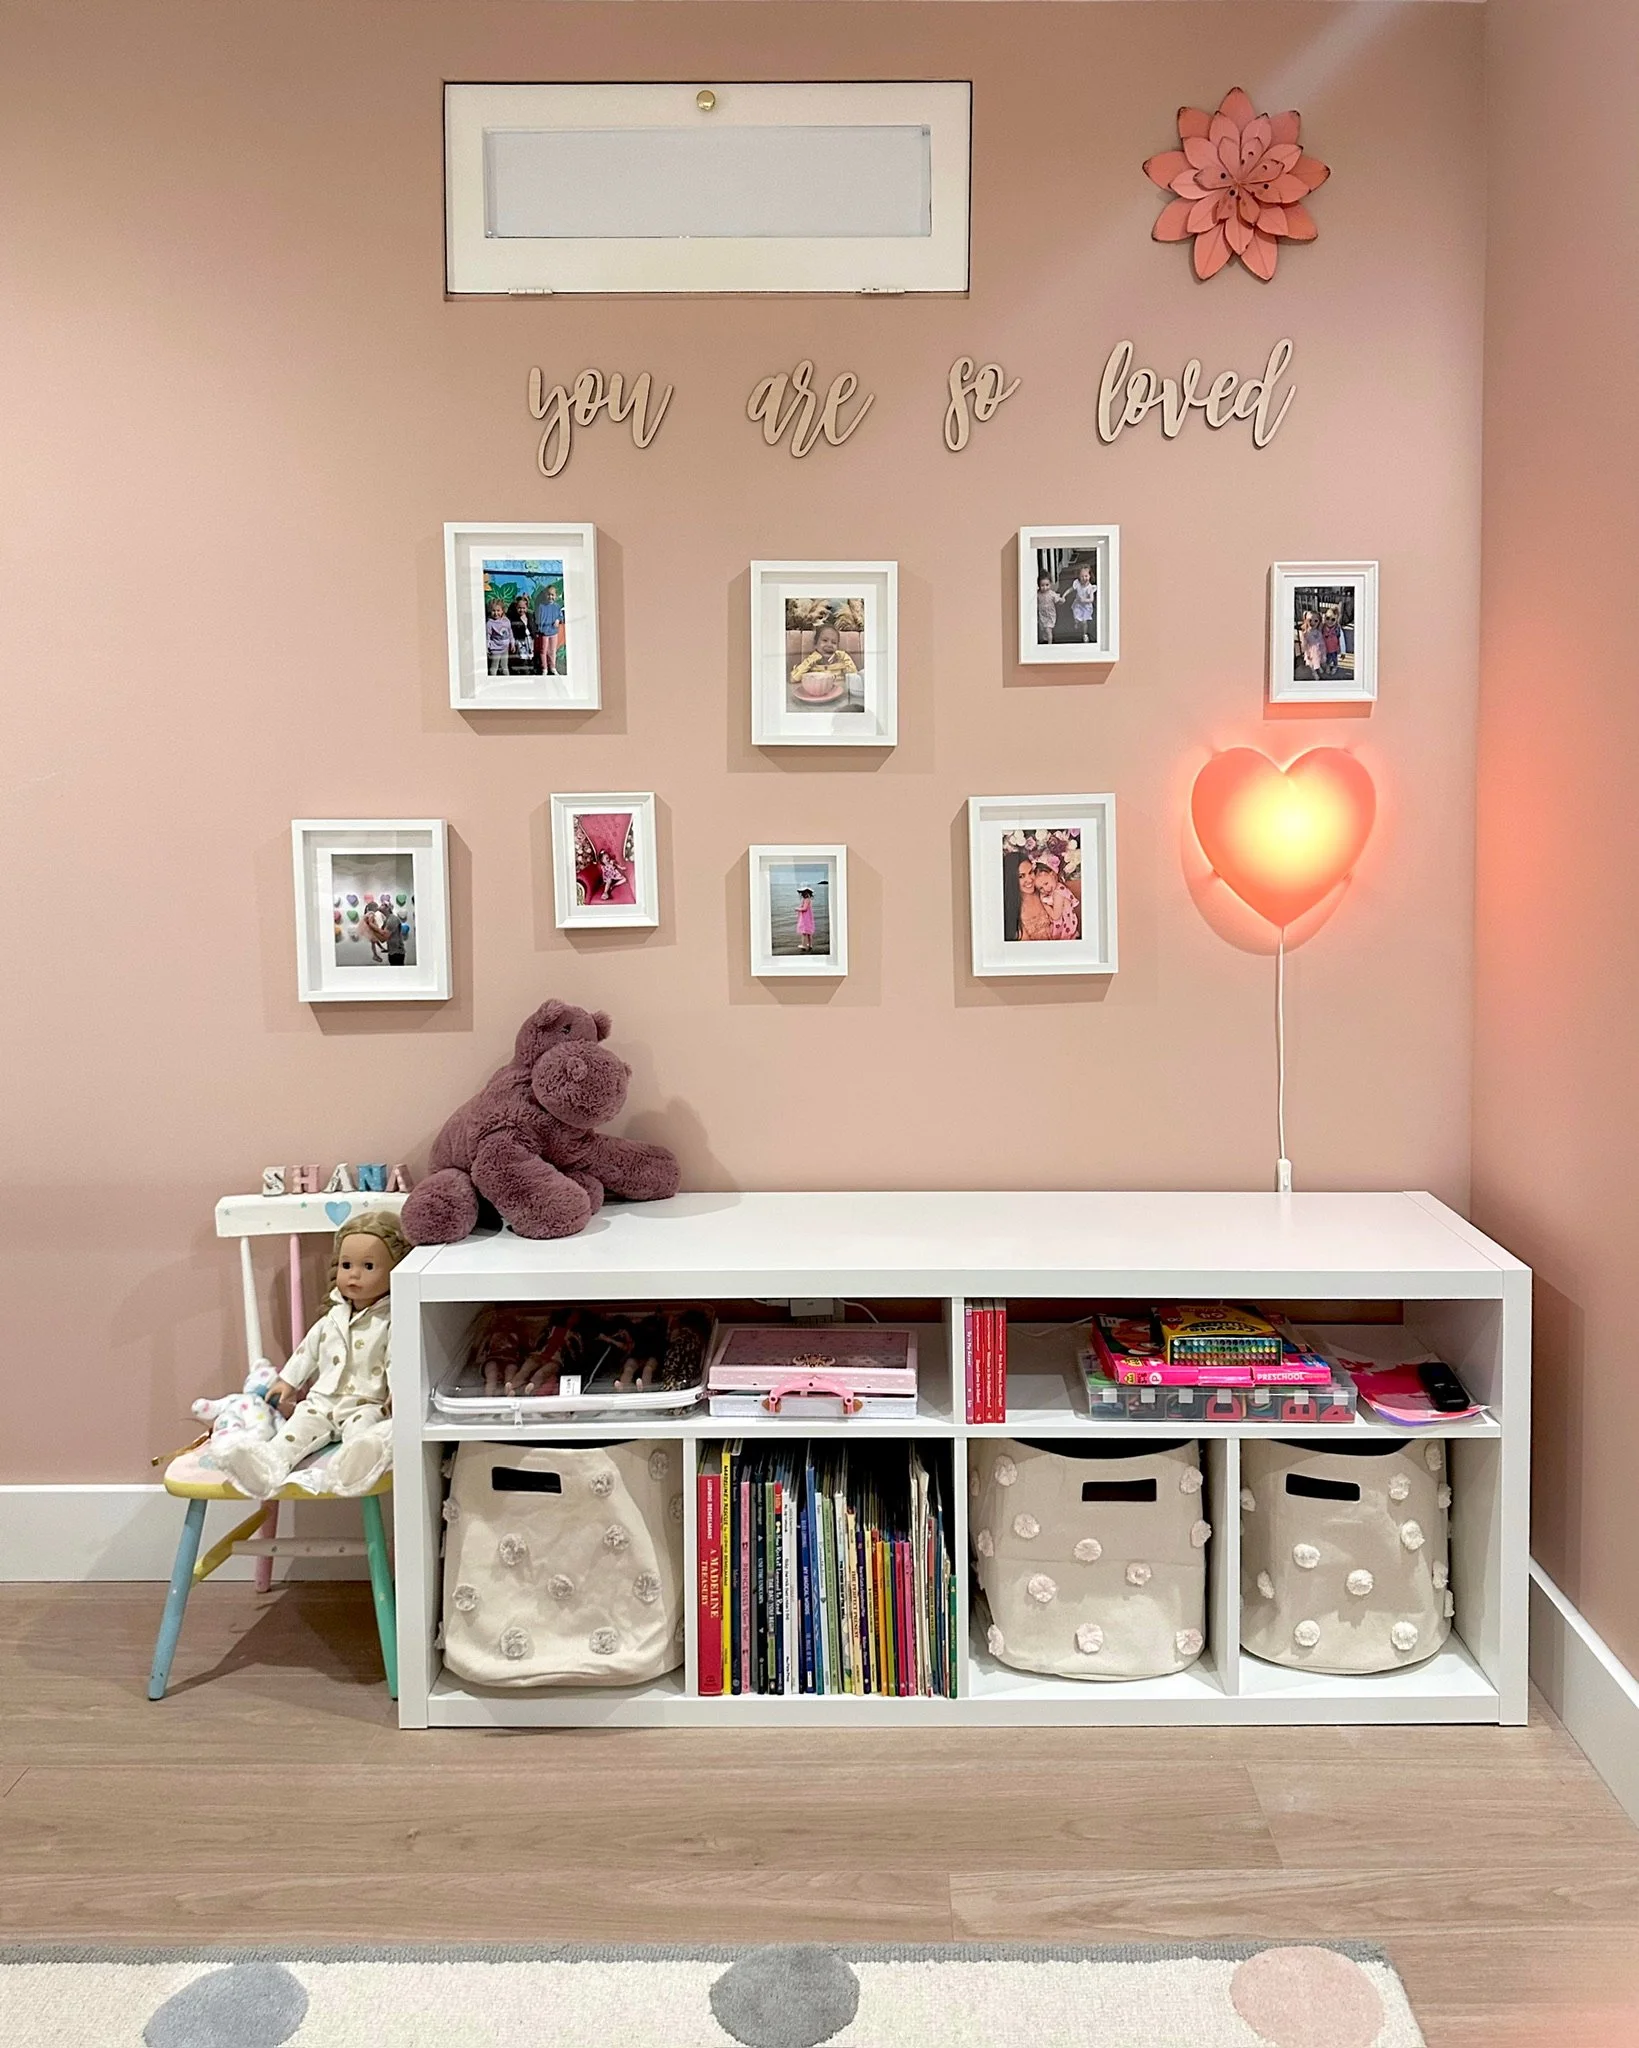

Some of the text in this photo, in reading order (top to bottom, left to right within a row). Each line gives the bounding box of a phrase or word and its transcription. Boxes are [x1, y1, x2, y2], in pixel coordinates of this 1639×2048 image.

[528, 339, 1298, 478] you are so loved
[262, 1163, 414, 1197] SHANA
[1187, 1324, 1257, 1334] Crayola
[1256, 1373, 1305, 1381] PRESCHOOL
[701, 1560, 709, 1606] TREASURY
[803, 1566, 808, 1575] MY
[709, 1557, 719, 1619] MADELINE
